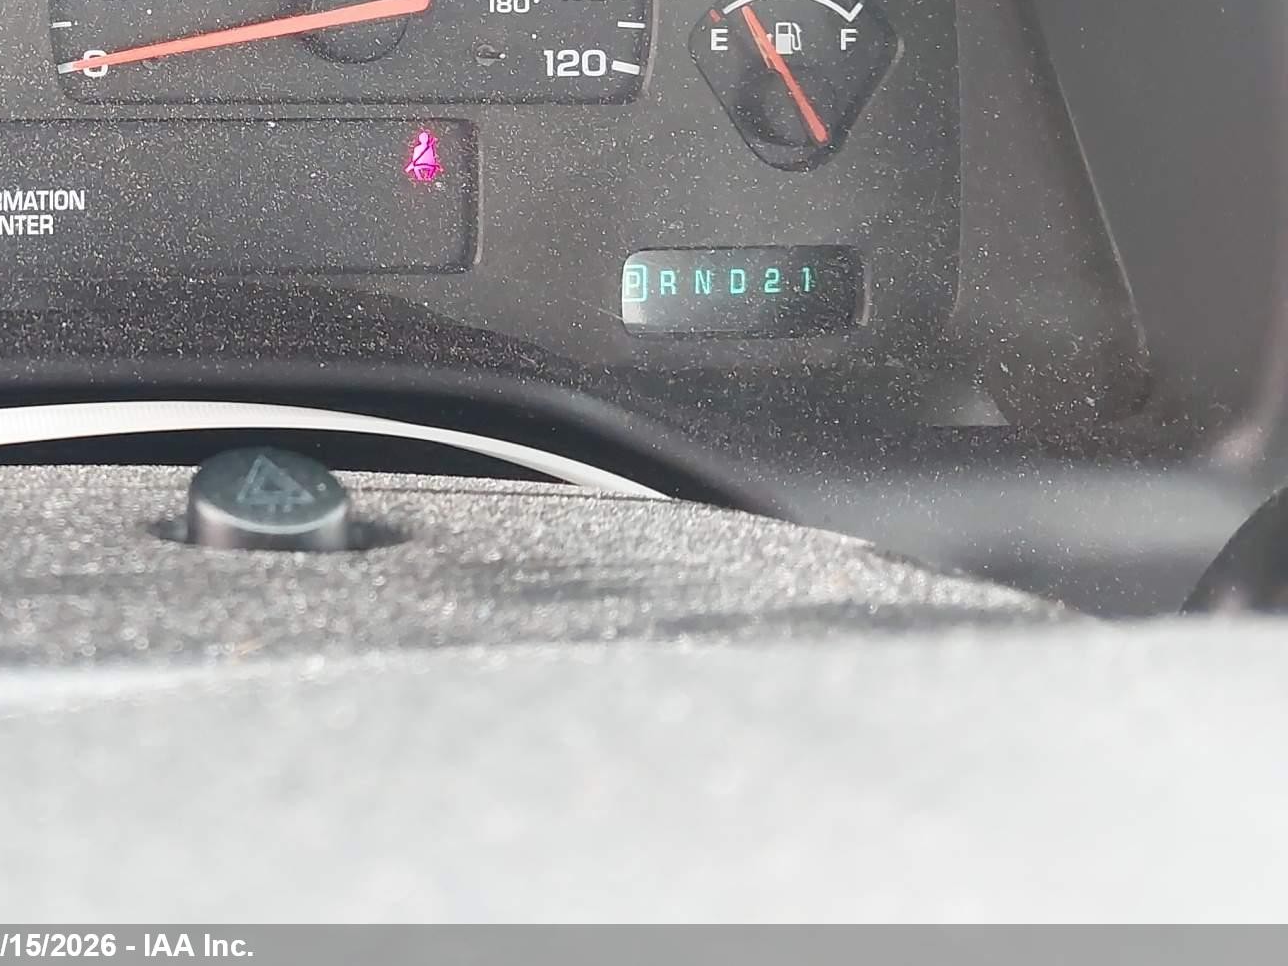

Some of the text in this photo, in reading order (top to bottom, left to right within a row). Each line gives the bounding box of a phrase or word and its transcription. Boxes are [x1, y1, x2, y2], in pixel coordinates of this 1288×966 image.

[710, 28, 728, 51] E
[840, 28, 857, 51] F
[83, 49, 109, 77] 0
[544, 49, 607, 78] 120
[661, 271, 677, 295] R
[695, 270, 711, 295] N
[730, 269, 746, 293] D
[764, 268, 781, 293] 2
[801, 267, 812, 292] 1
